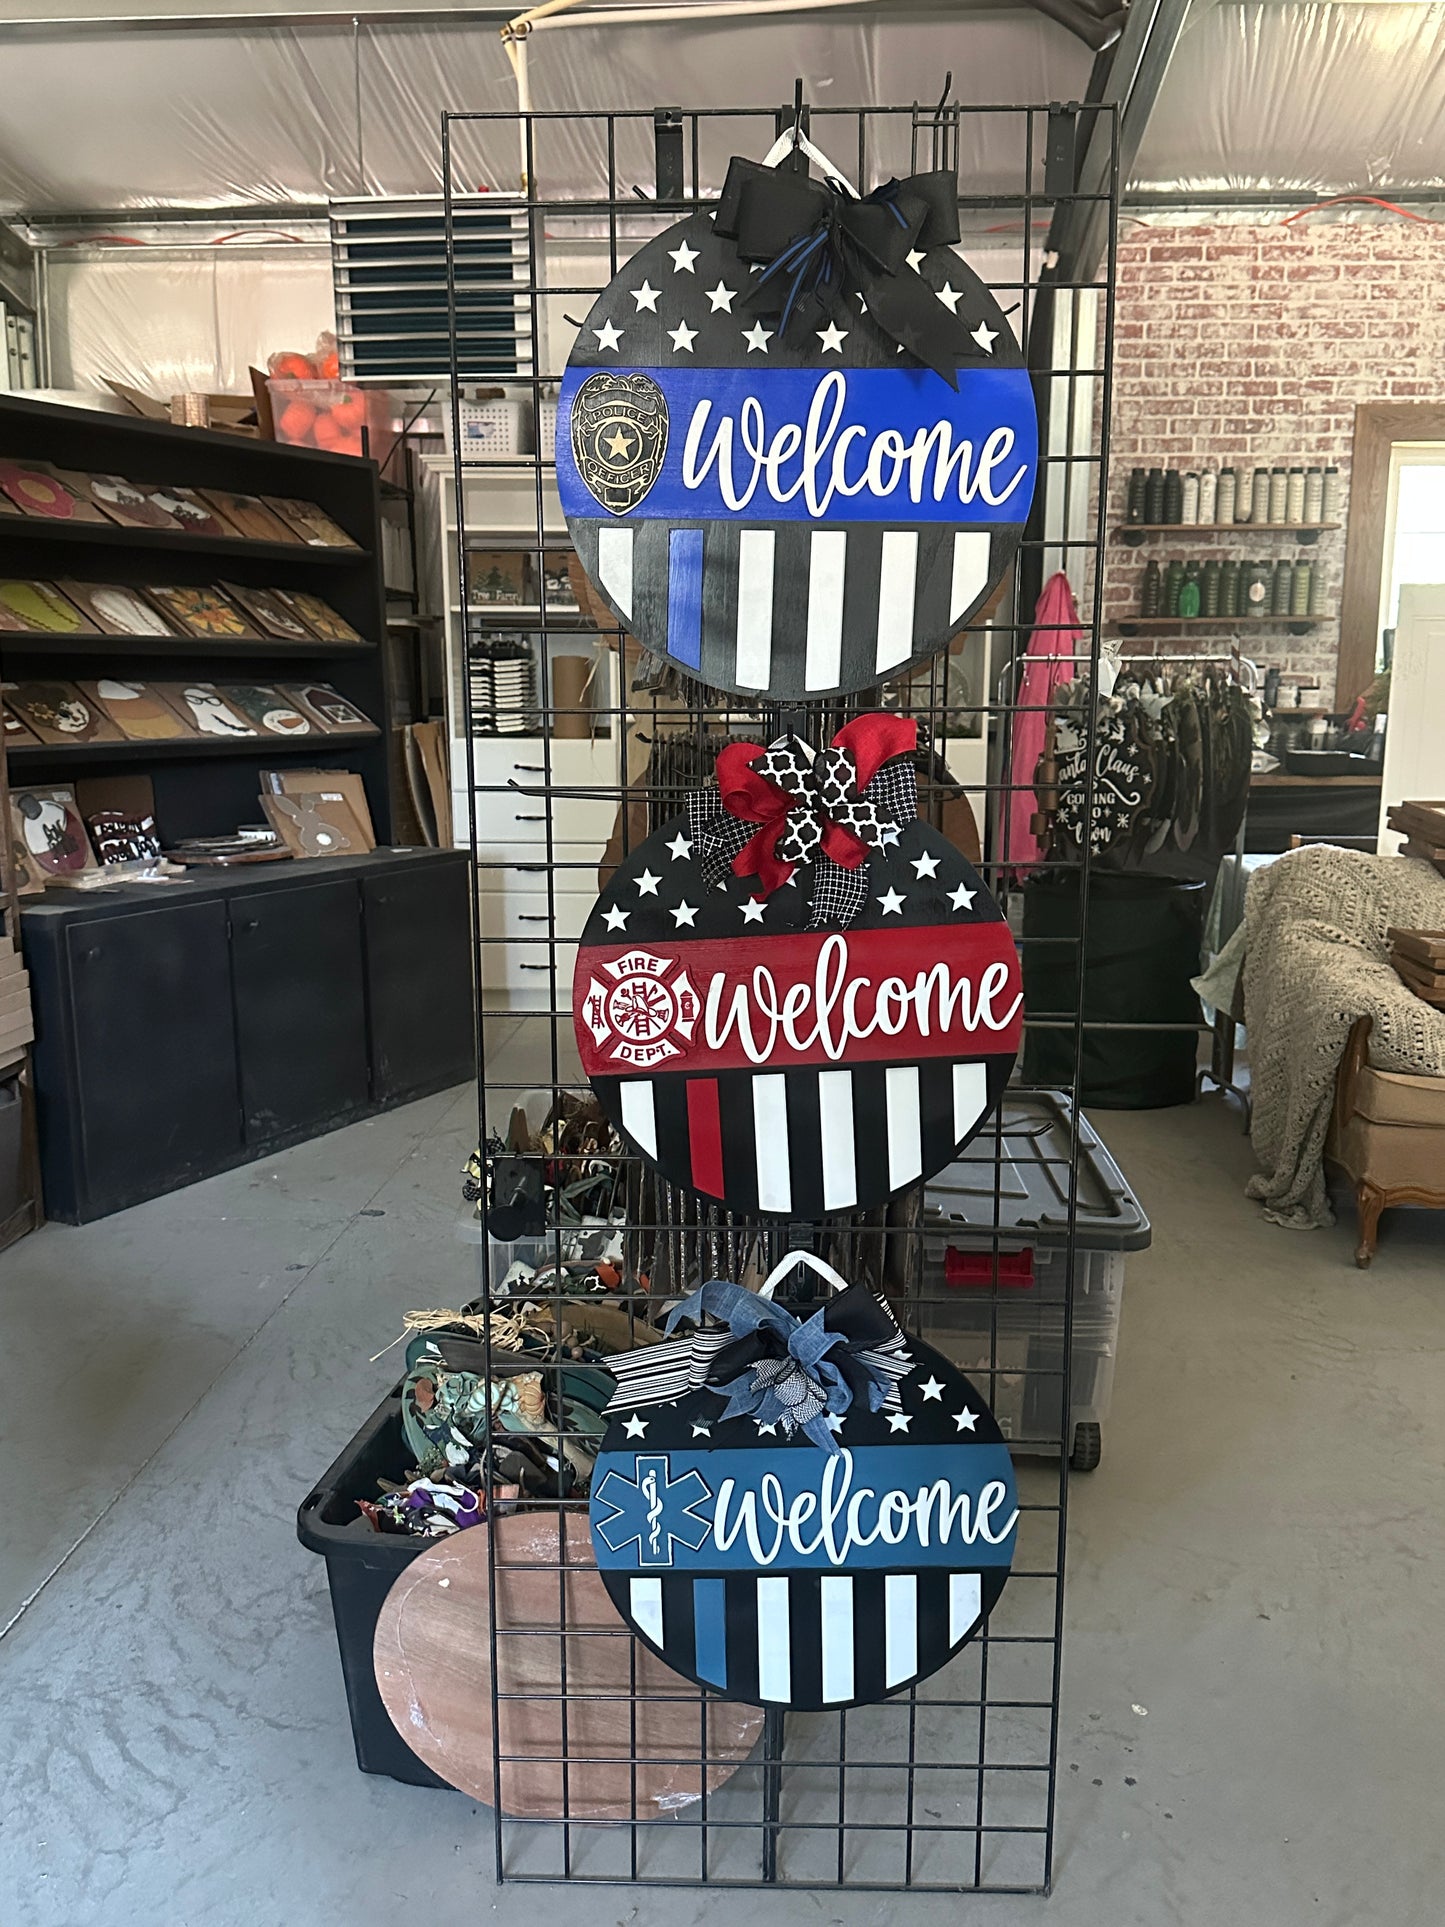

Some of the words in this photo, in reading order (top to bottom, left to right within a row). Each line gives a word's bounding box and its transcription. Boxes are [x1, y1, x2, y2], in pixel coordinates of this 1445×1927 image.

[592, 406, 646, 423] POLICE
[587, 461, 650, 484] OFFICER
[1058, 749, 1087, 783] anta
[1095, 743, 1140, 783] Claus
[617, 957, 659, 974] FIRE
[619, 1043, 672, 1061] DEPT.
